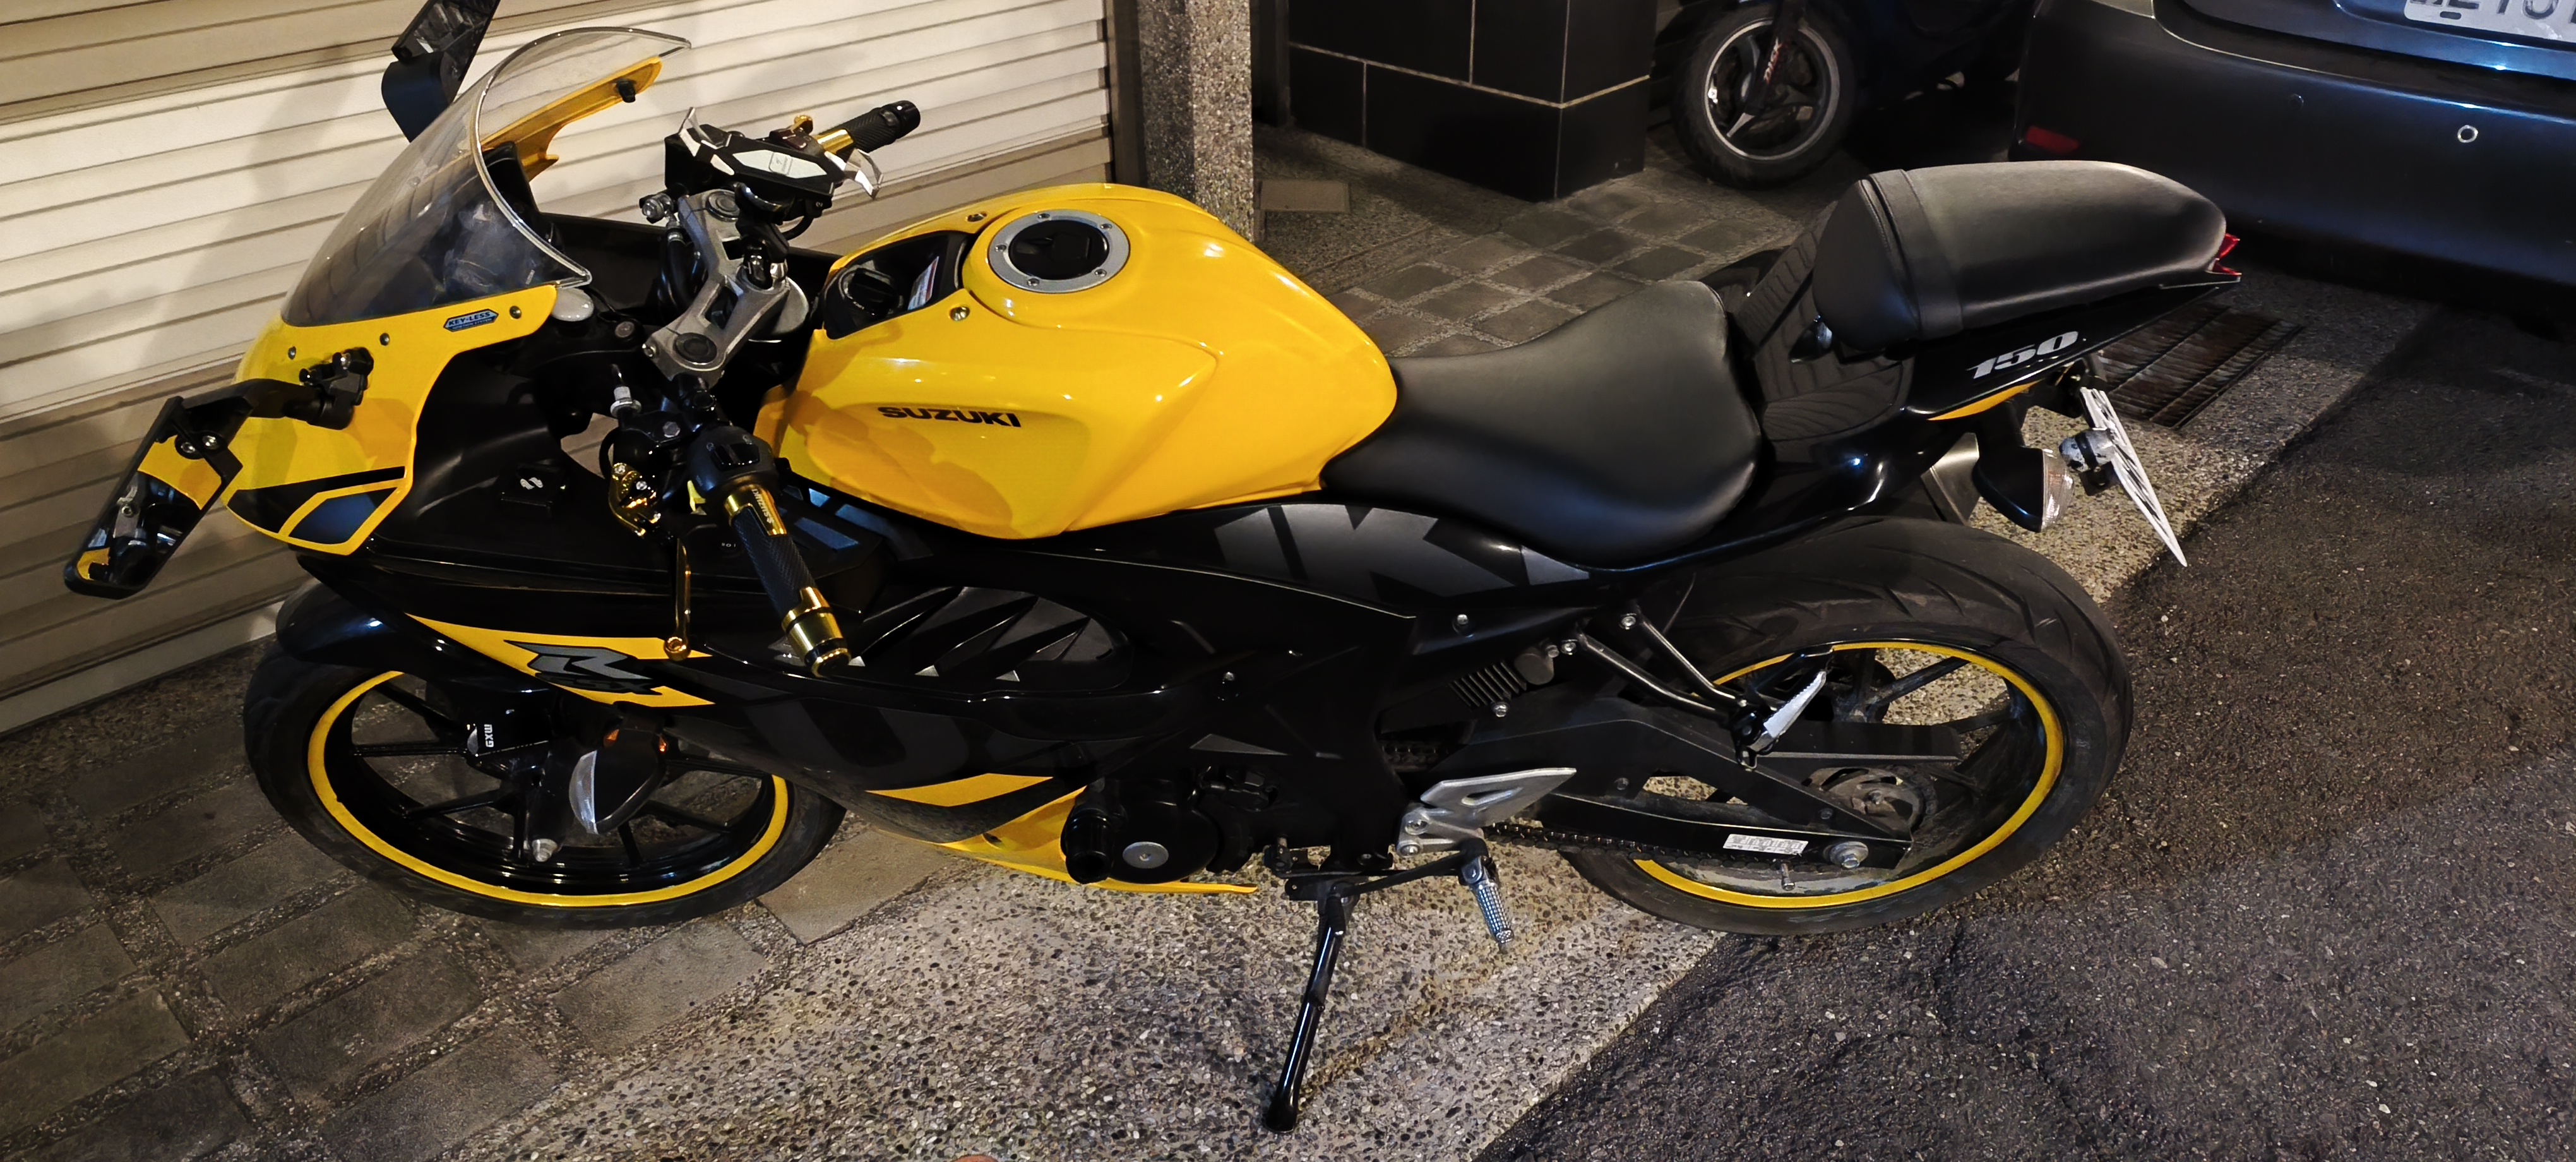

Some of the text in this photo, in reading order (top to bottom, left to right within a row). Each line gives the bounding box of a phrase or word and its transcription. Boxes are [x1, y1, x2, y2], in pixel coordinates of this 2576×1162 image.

[448, 311, 491, 326] KEY-LESS
[1965, 331, 2078, 379] 150
[878, 407, 1022, 428] SUZUKI
[751, 488, 770, 517] SUZUKI
[484, 724, 494, 748] GXW
